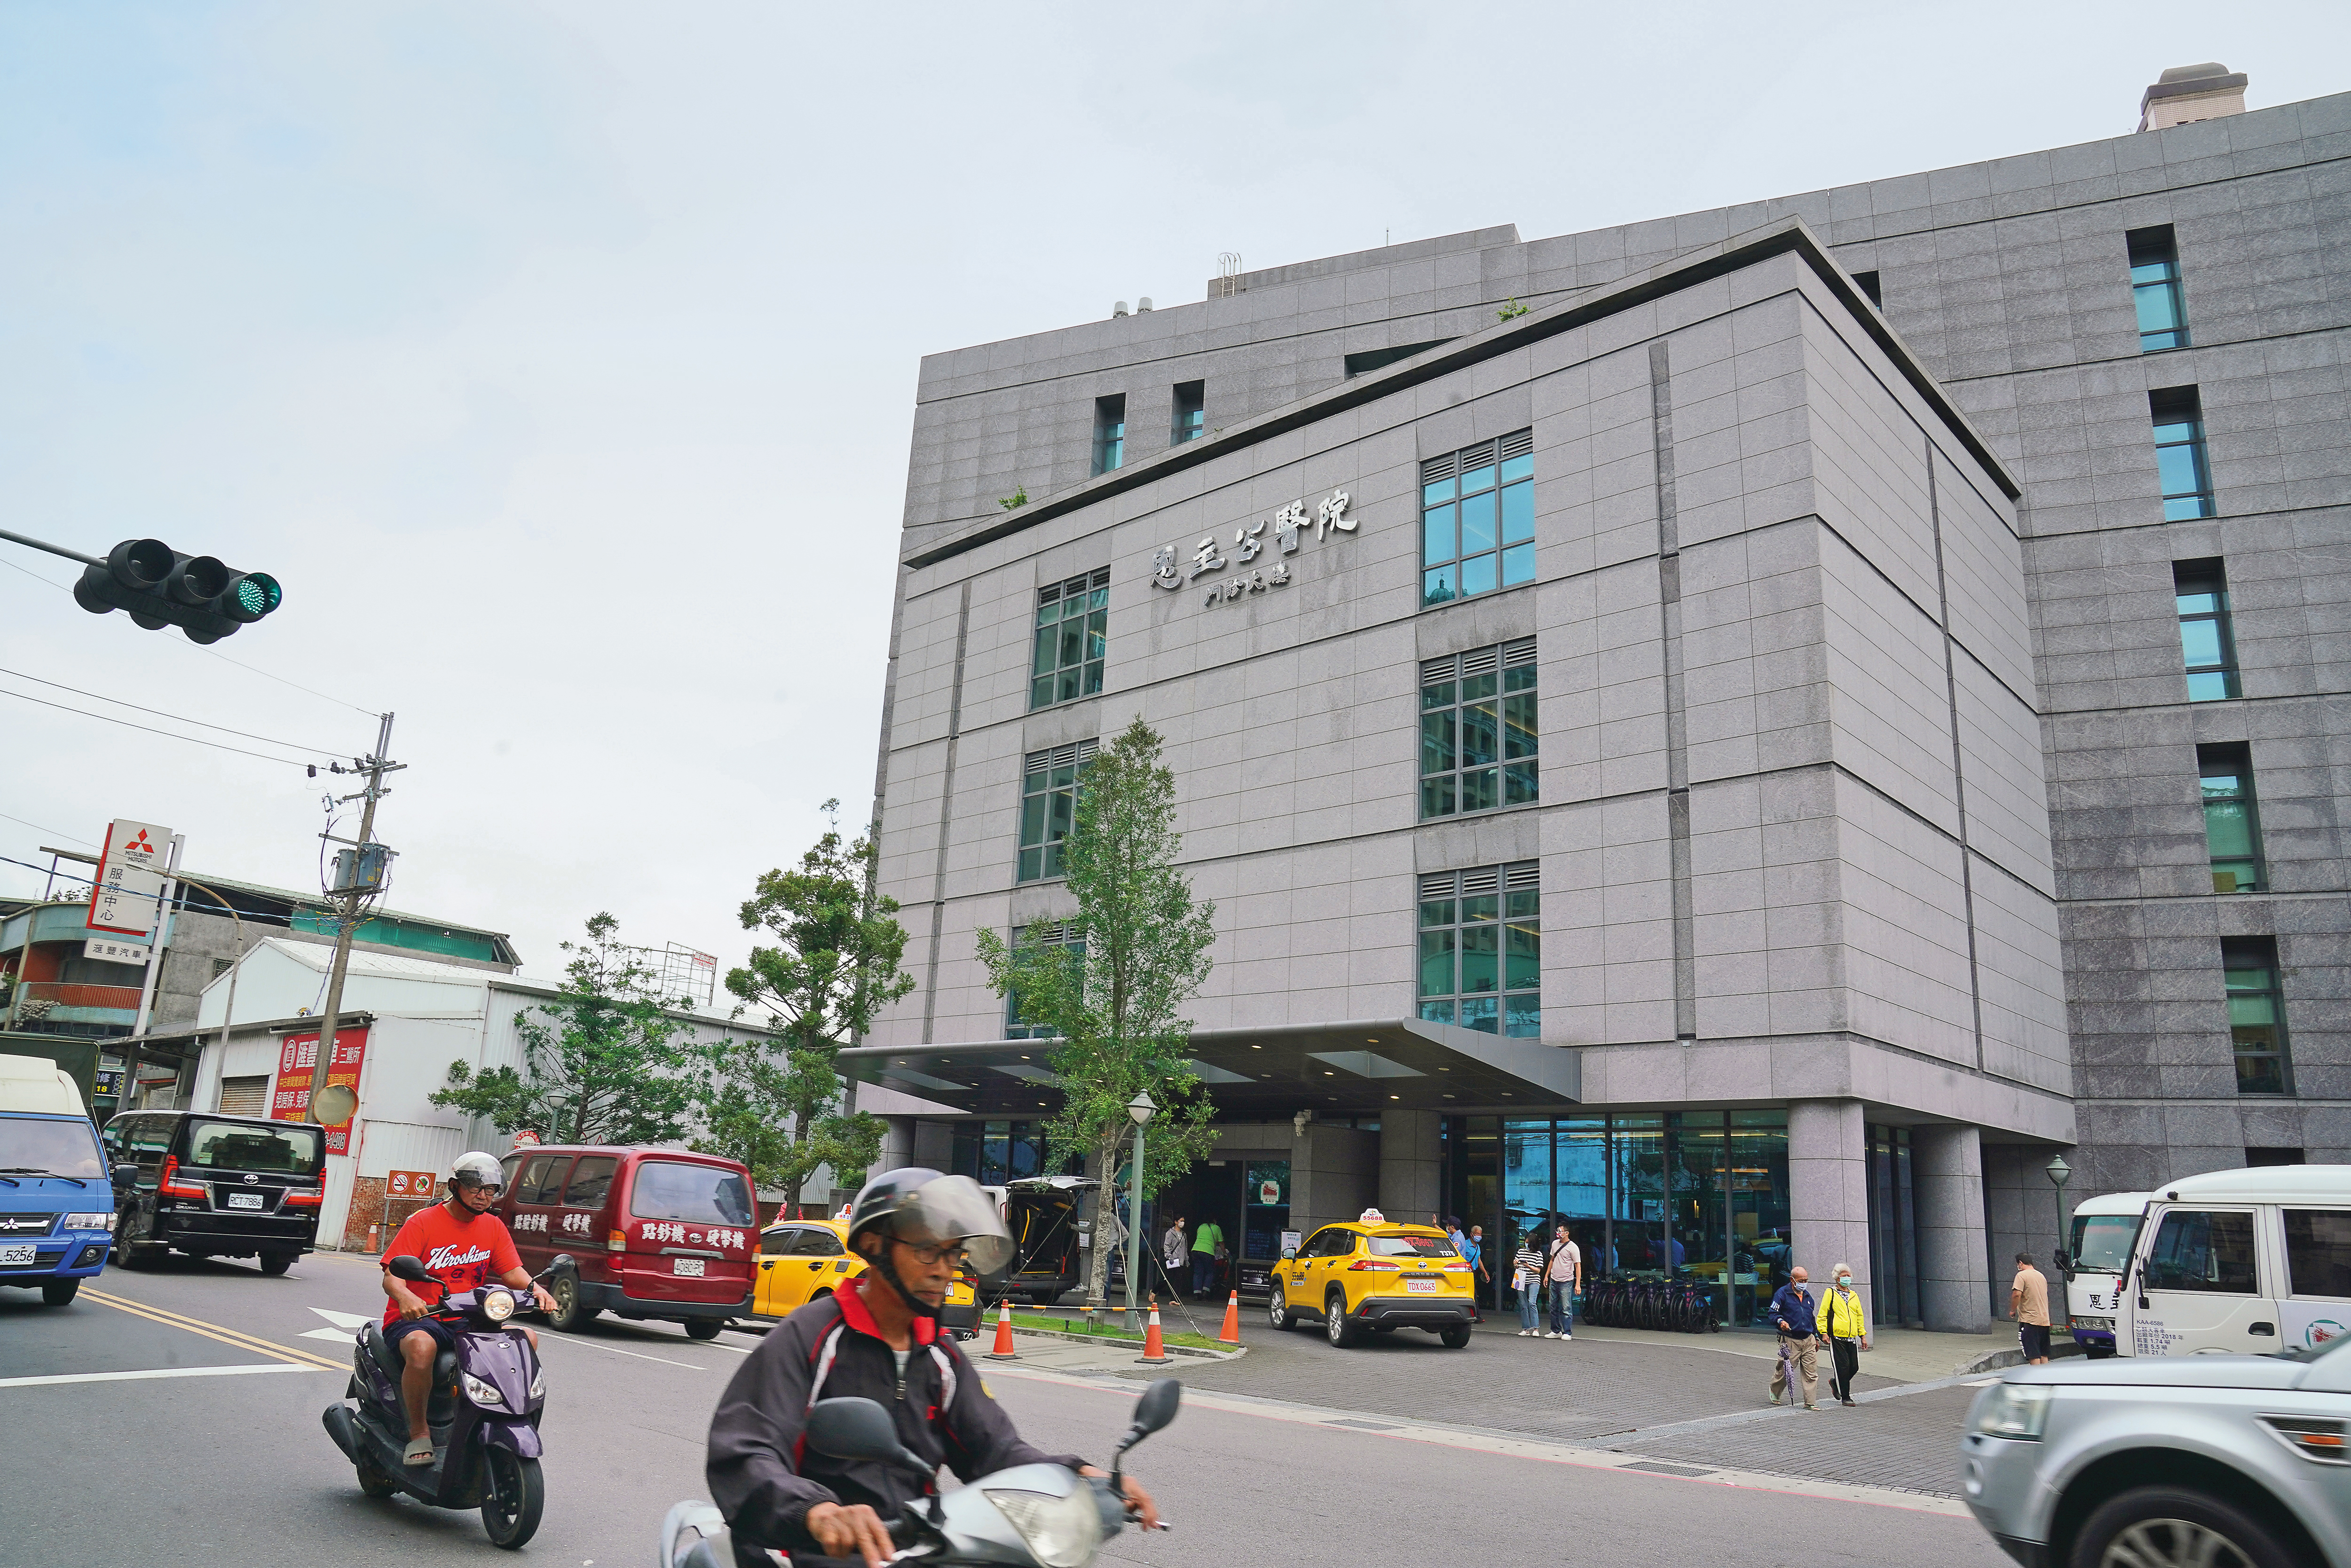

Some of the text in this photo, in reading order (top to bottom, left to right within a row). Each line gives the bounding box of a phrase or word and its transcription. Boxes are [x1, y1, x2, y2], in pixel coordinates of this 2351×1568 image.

[1149, 489, 1359, 589] 恩主公醫院
[1203, 560, 1291, 606] 門診大樓
[125, 851, 152, 859] MITSUBISHI
[100, 867, 123, 921] 服務中心
[229, 1196, 261, 1206] RCT-7886
[642, 1222, 746, 1250] 點鈔機 硬幣機
[0, 1250, 35, 1261] -5256
[424, 1244, 491, 1269] Hiroshima
[1292, 1271, 1305, 1280] 55688
